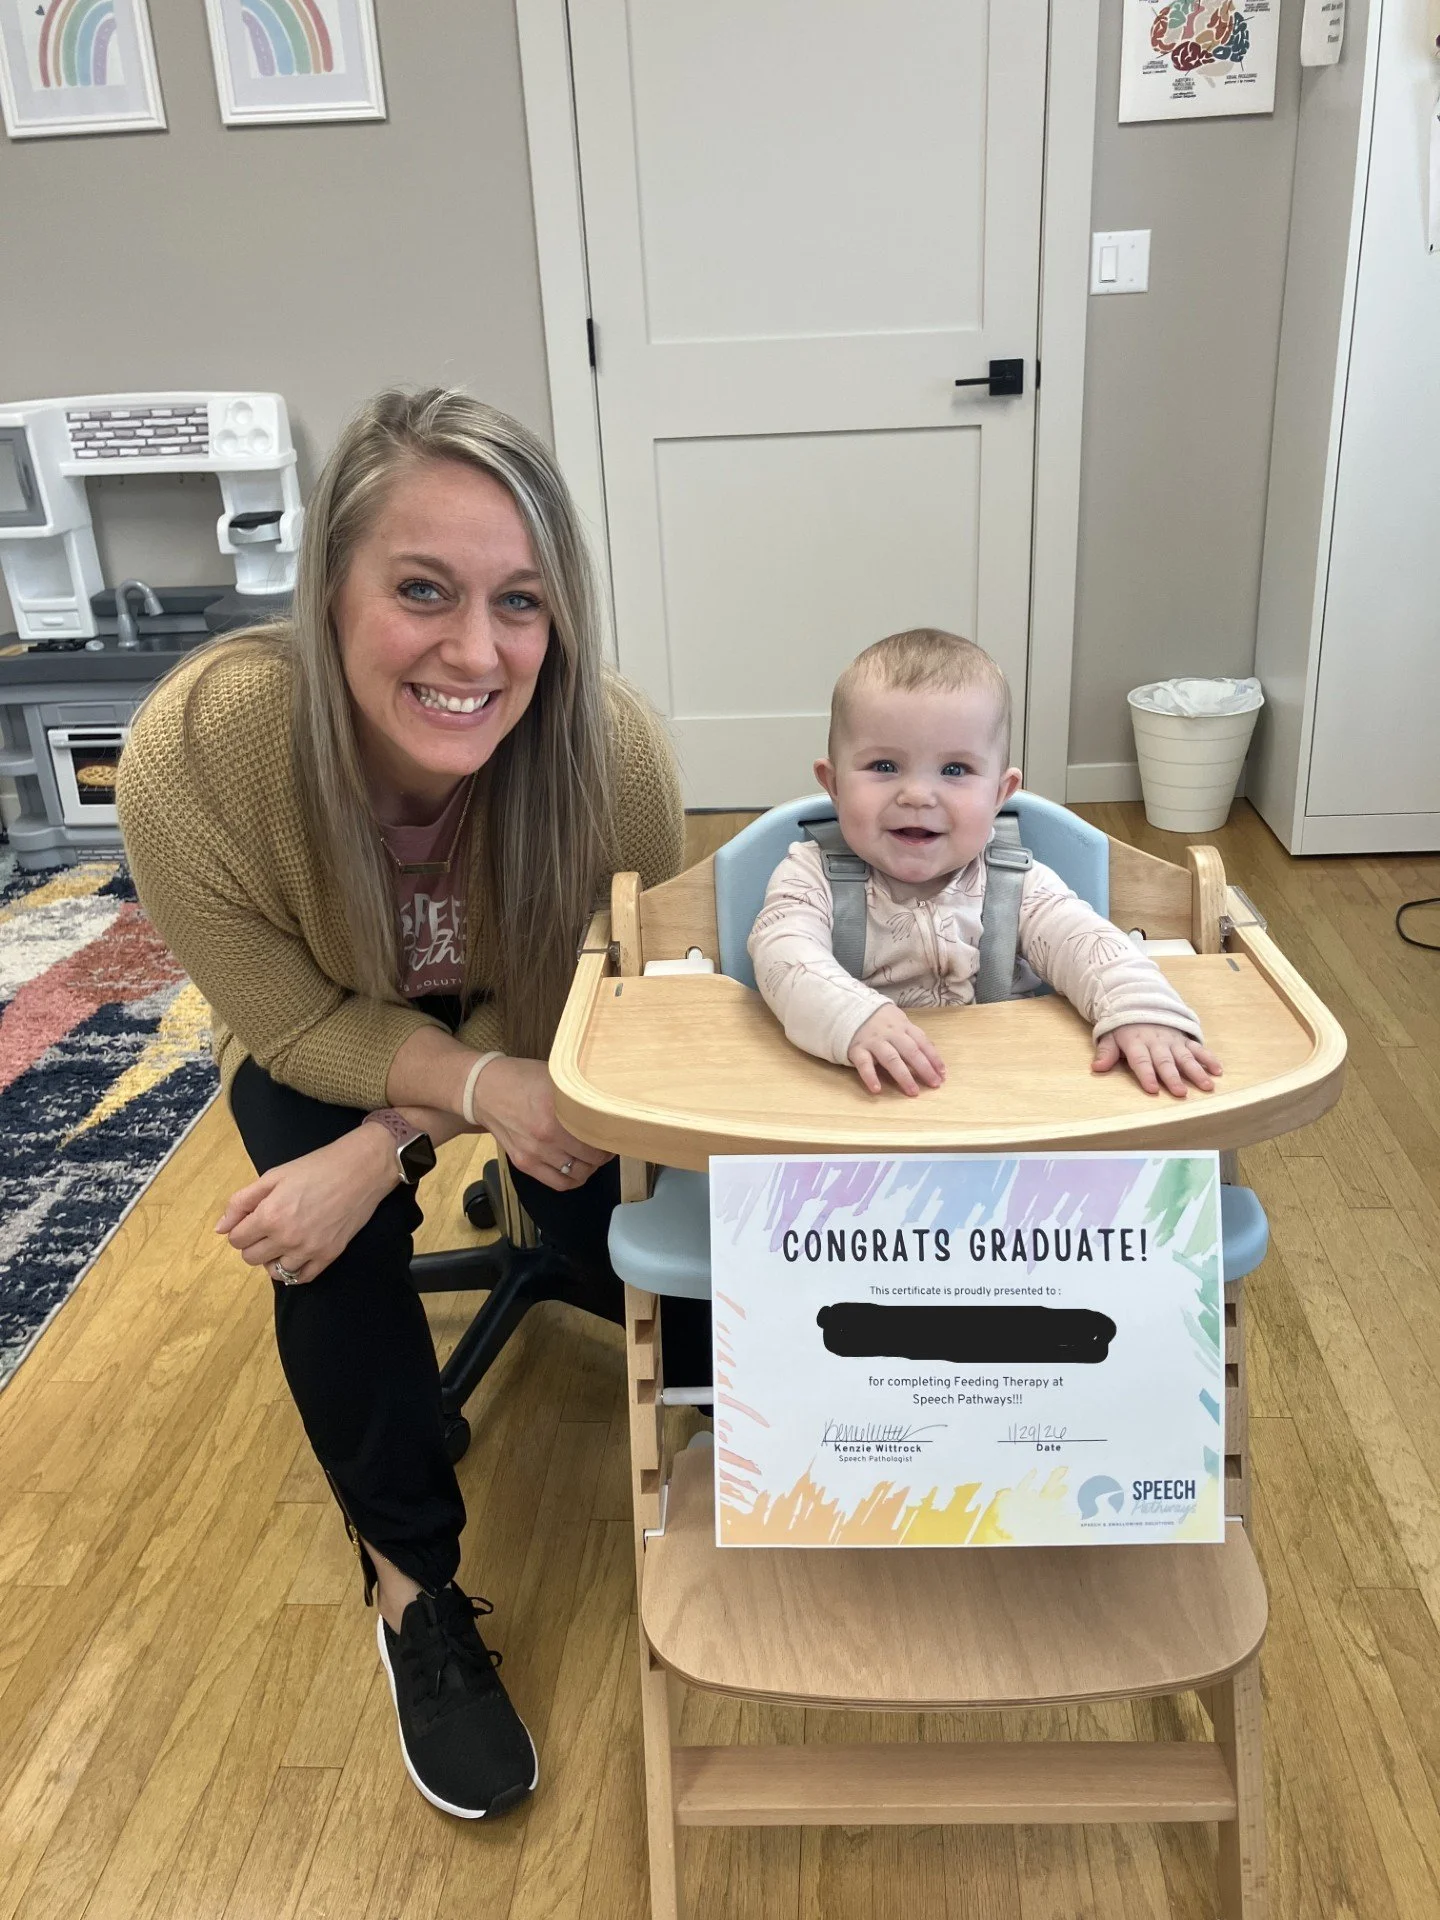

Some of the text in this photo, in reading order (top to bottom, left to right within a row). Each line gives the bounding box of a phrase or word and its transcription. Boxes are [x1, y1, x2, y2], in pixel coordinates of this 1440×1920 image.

[400, 892, 467, 940] SPEE
[782, 1227, 1148, 1263] CONGRATS GRADUATE!
[869, 1285, 890, 1296] This
[891, 1285, 942, 1296] certificate
[943, 1286, 952, 1296] is
[953, 1285, 992, 1297] proudly
[993, 1285, 1044, 1297] presented
[868, 1376, 1064, 1390] for completing Feeding Therapy at
[912, 1393, 1023, 1407] Speech Pathways!!!
[834, 1444, 922, 1453] Kenzie Wittrock
[1036, 1443, 1062, 1452] Date
[838, 1454, 913, 1464] Speech Pathologist
[1132, 1479, 1196, 1501] SPEECH
[1131, 1500, 1197, 1525] Pathways
